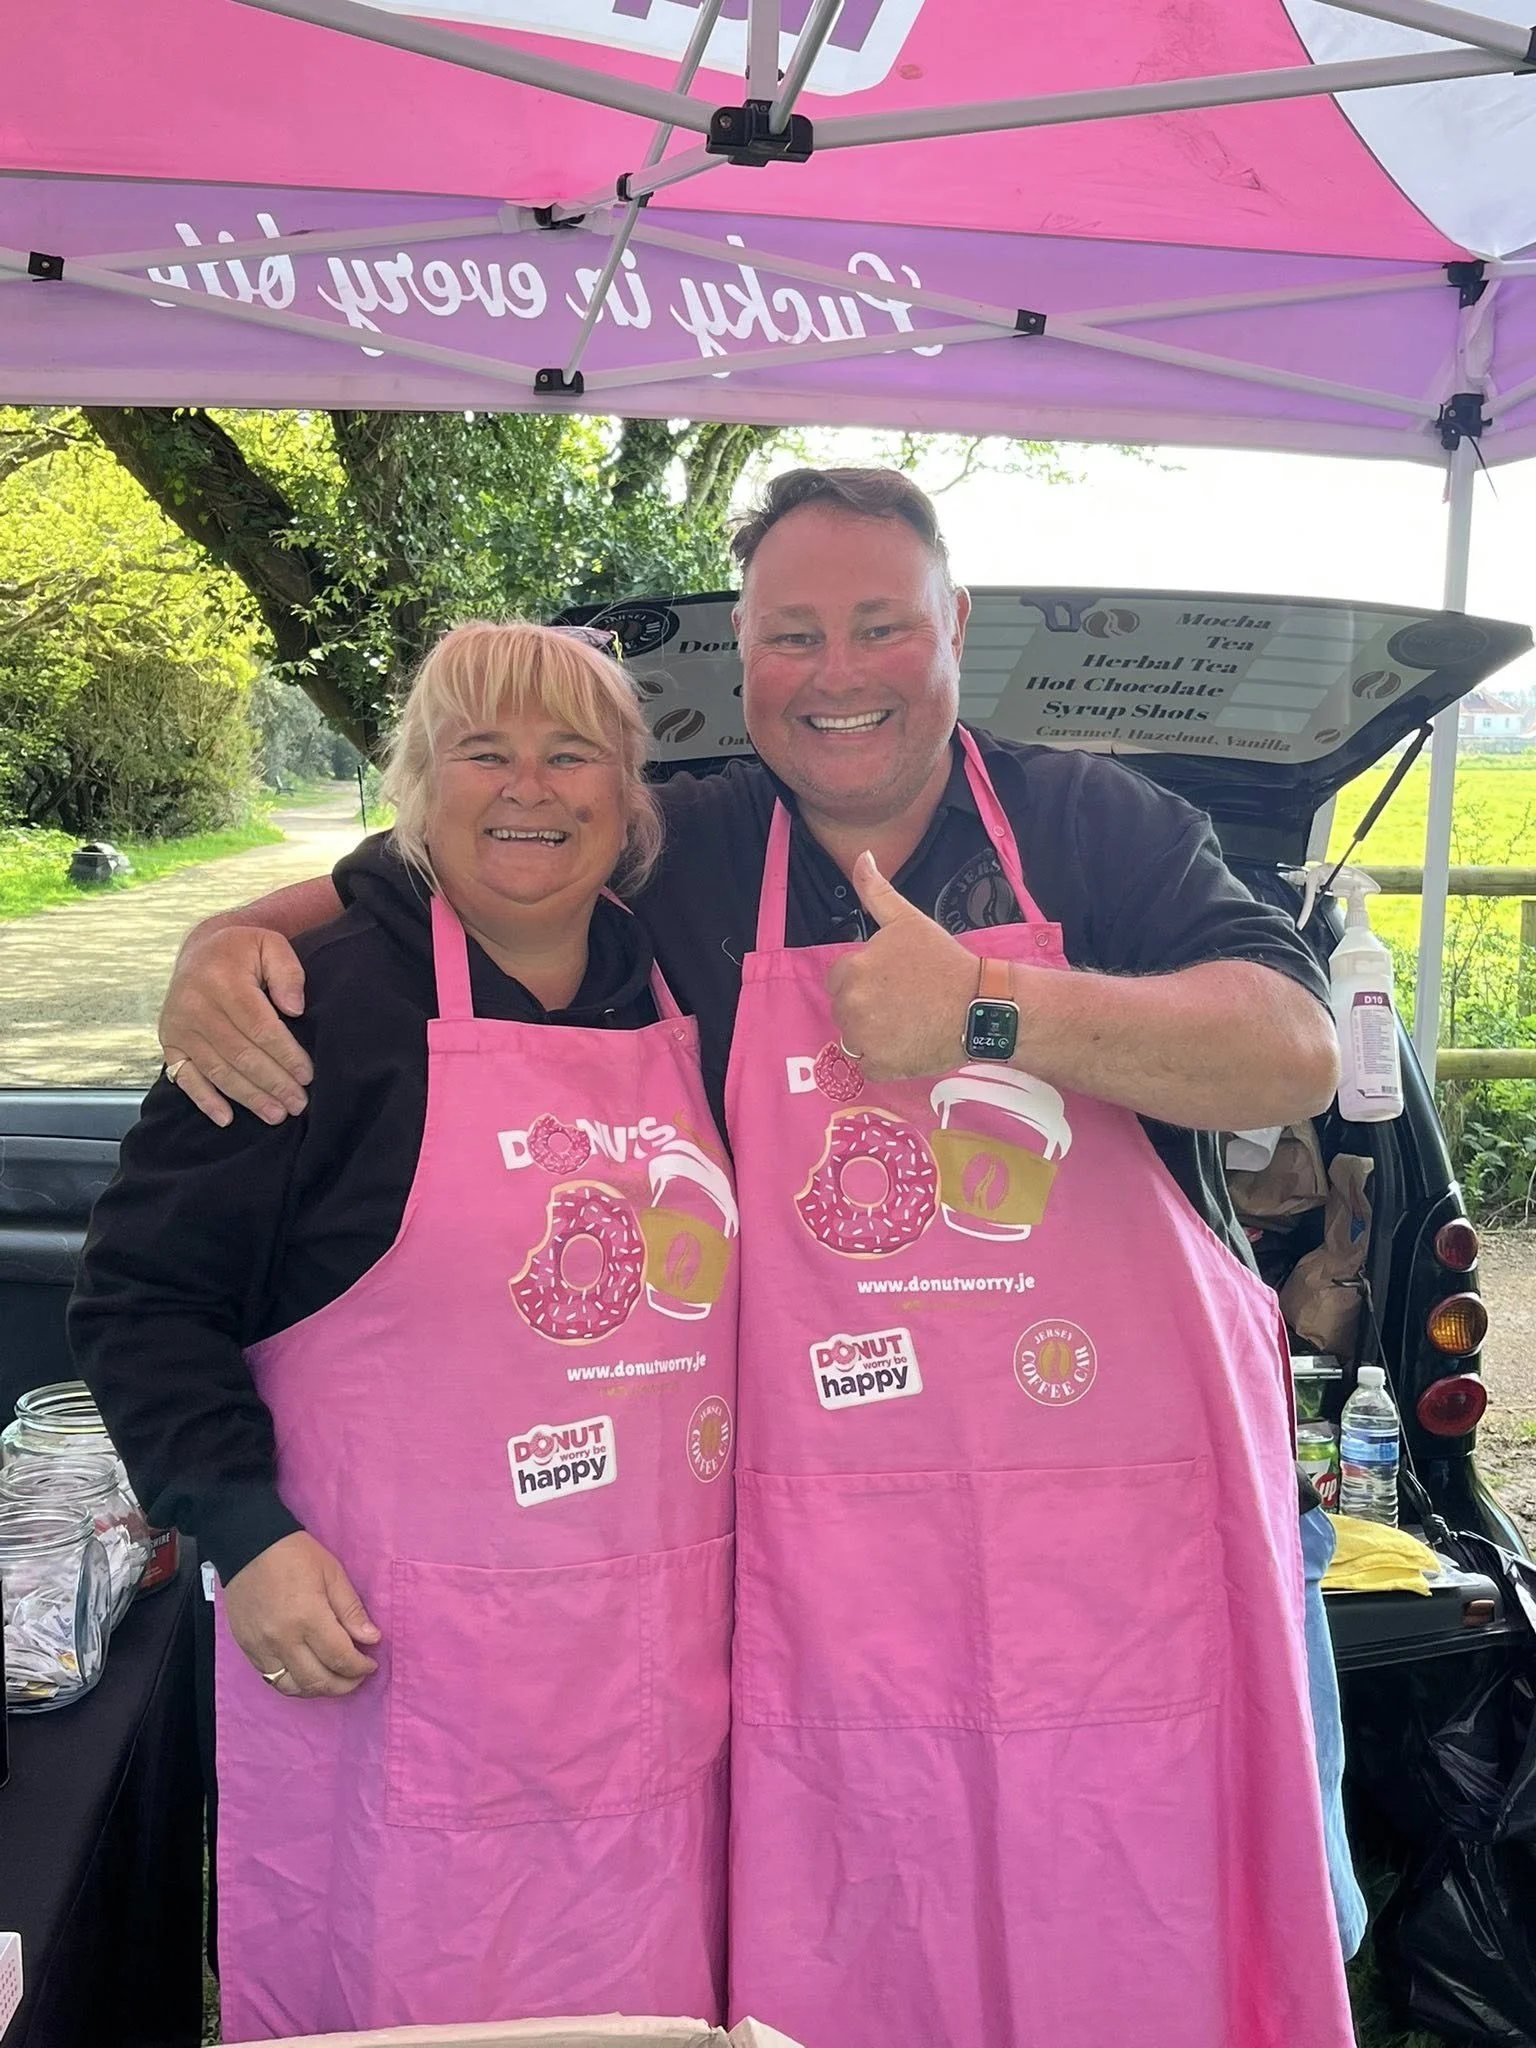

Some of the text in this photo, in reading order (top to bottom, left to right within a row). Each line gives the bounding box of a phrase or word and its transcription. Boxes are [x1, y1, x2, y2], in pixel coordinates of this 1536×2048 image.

[1176, 613, 1271, 629] Mocha
[1206, 635, 1254, 651] Tea
[1082, 654, 1238, 674] Herbal Tea
[1025, 676, 1224, 698] Hot Chocolate
[1042, 700, 1209, 722] Syrup Shots
[1227, 736, 1291, 751] Vanilla
[1364, 995, 1383, 1004] D10
[857, 1272, 1036, 1294] www.donutworry.je
[1034, 1328, 1073, 1345] JERSEY
[816, 1334, 902, 1369] DONUT
[567, 1351, 706, 1381] www.donutworry.je
[863, 1358, 892, 1370] worry
[1021, 1345, 1090, 1399] COFFEE CAR
[821, 1365, 908, 1398] happy
[514, 1422, 604, 1464] DONUT
[560, 1445, 606, 1462] worry be
[518, 1455, 607, 1494] happy
